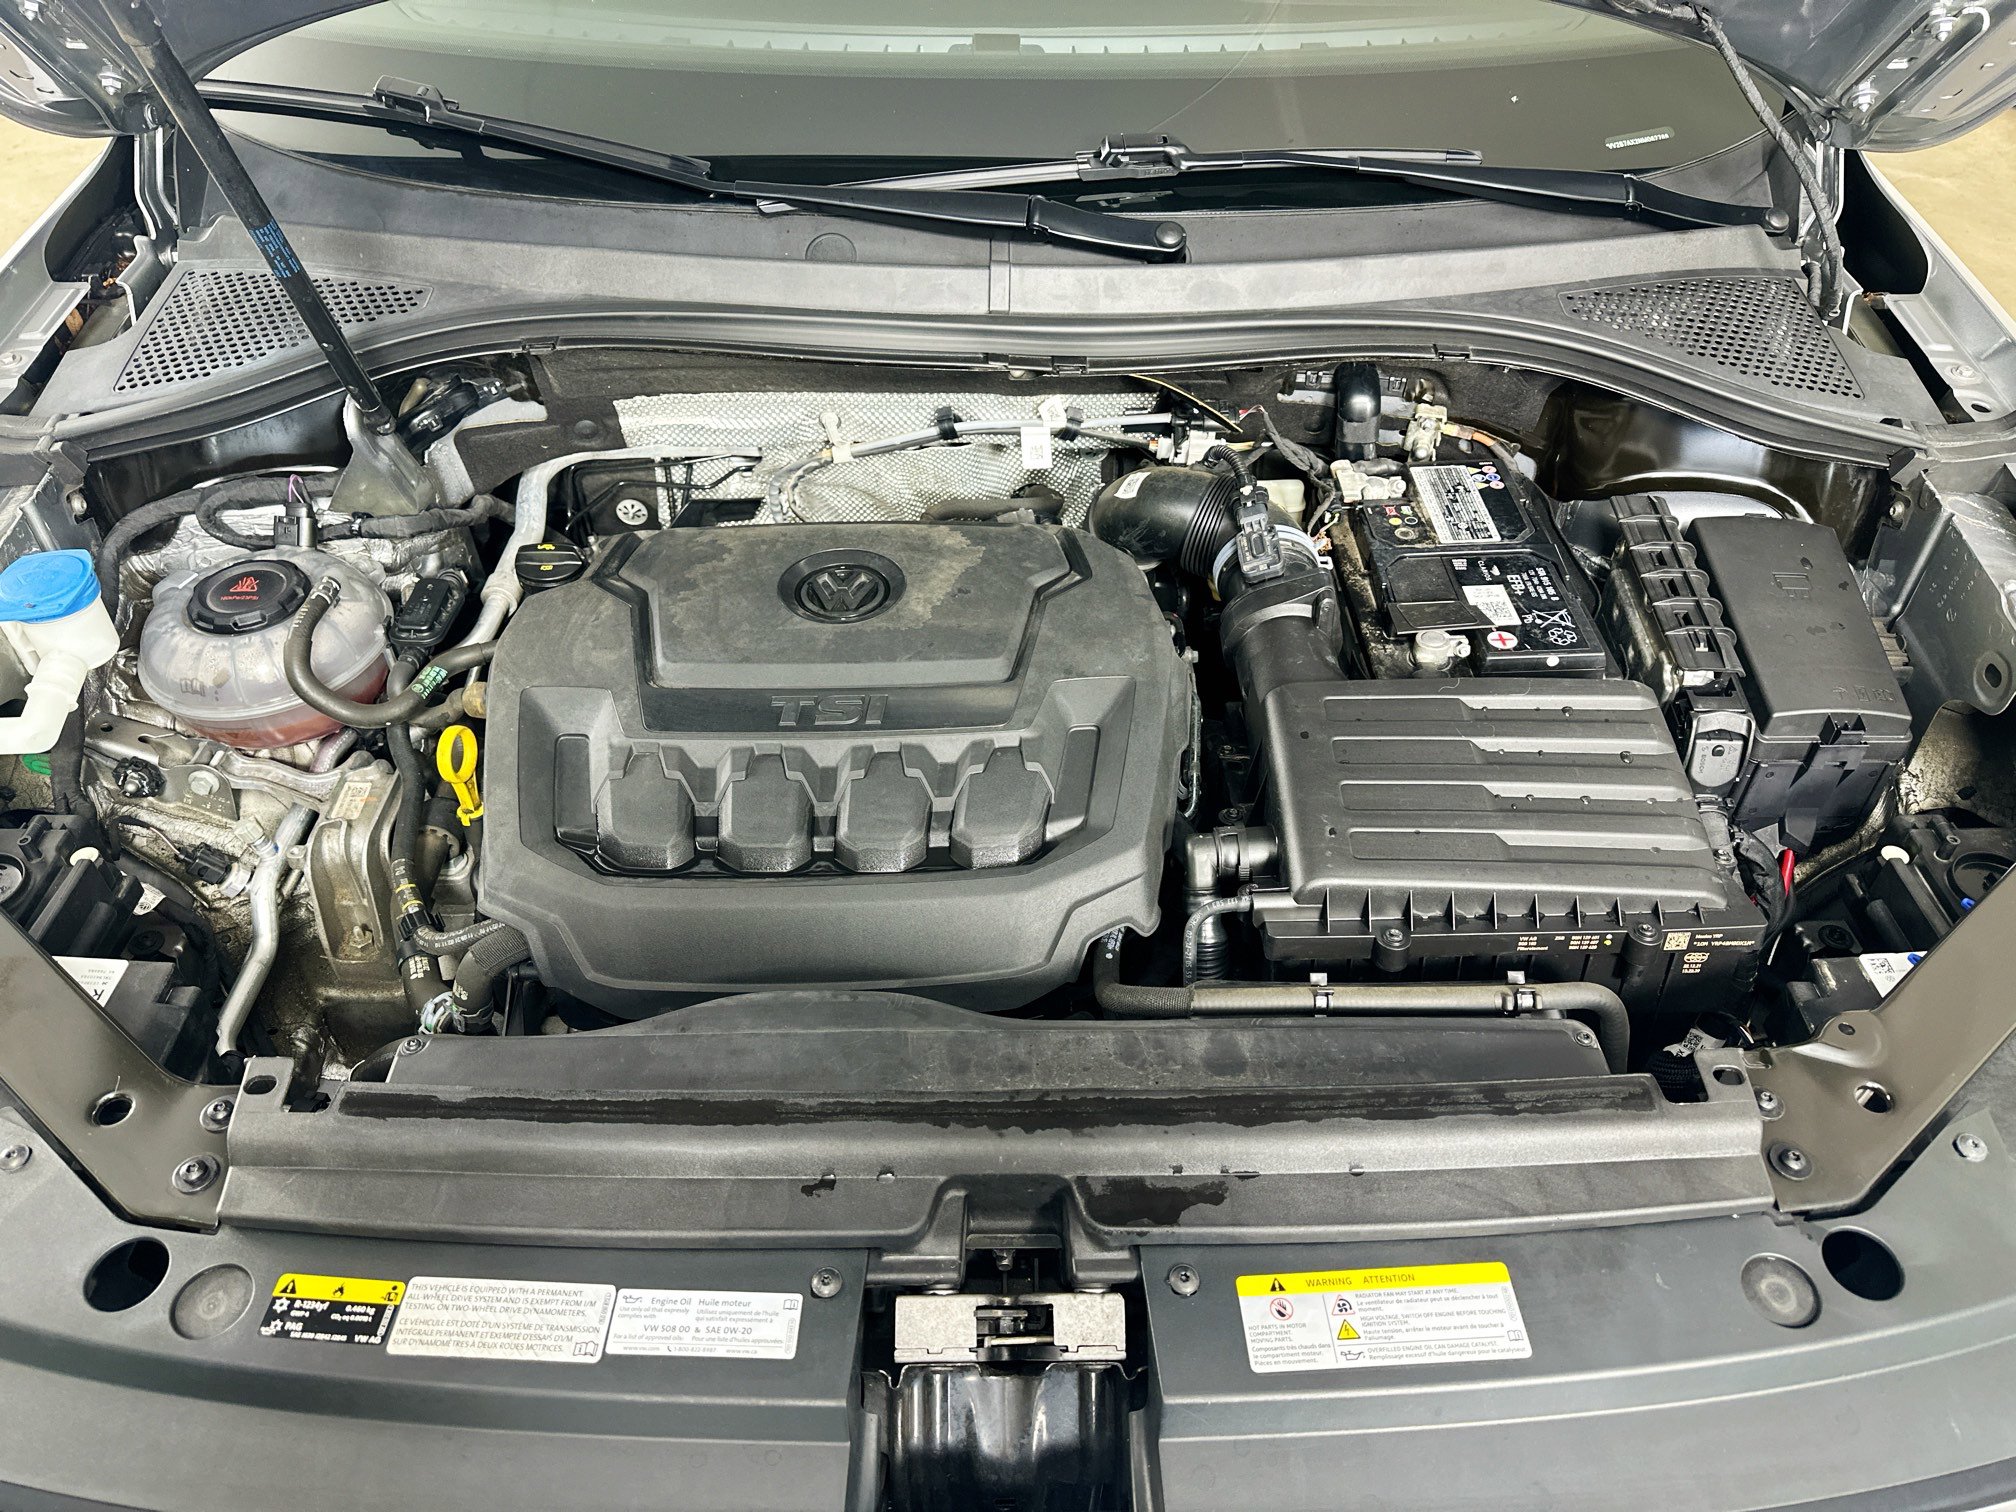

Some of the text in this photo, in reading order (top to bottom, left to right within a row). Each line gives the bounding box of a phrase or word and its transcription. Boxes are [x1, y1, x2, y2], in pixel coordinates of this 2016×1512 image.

[1478, 560, 1492, 581] CLARIOS
[1507, 575, 1525, 595] EFB+
[1522, 614, 1533, 623] Pb
[771, 694, 888, 726] TSI
[1306, 1274, 1415, 1287] WARNING ATTENTION
[429, 1284, 461, 1292] VEHICLE
[470, 1286, 507, 1294] EQUIPPED
[537, 1289, 584, 1297] PERMANENT
[407, 1292, 450, 1301] ALL-WHEEL
[474, 1295, 502, 1303] SYSTEM
[651, 1297, 678, 1306] Engine
[366, 1307, 376, 1315] kg
[405, 1302, 435, 1310] TESTING
[451, 1304, 498, 1313] TWO-WHEEL
[523, 1307, 586, 1317] DYNAMOMETERS.
[284, 1322, 303, 1331] PAG
[410, 1317, 445, 1326] VÉHICULE
[446, 1319, 459, 1327] EST
[460, 1319, 480, 1328] DOTÉ
[482, 1320, 500, 1329] D'UN
[502, 1322, 533, 1330] SYSTÈME
[546, 1324, 600, 1333] TRANSMISSION
[396, 1326, 434, 1336] INTÉGRALE
[436, 1329, 478, 1338] PERMANENT
[355, 1335, 368, 1343] VW
[408, 1337, 468, 1347] DYNAMOMÈTRES
[470, 1339, 476, 1347] À
[477, 1341, 497, 1349] DEUX
[499, 1342, 524, 1350] ROUES
[526, 1344, 563, 1352] MOTRICES.
[1252, 1345, 1285, 1353] Composants
[1260, 1352, 1300, 1360] compartiment
